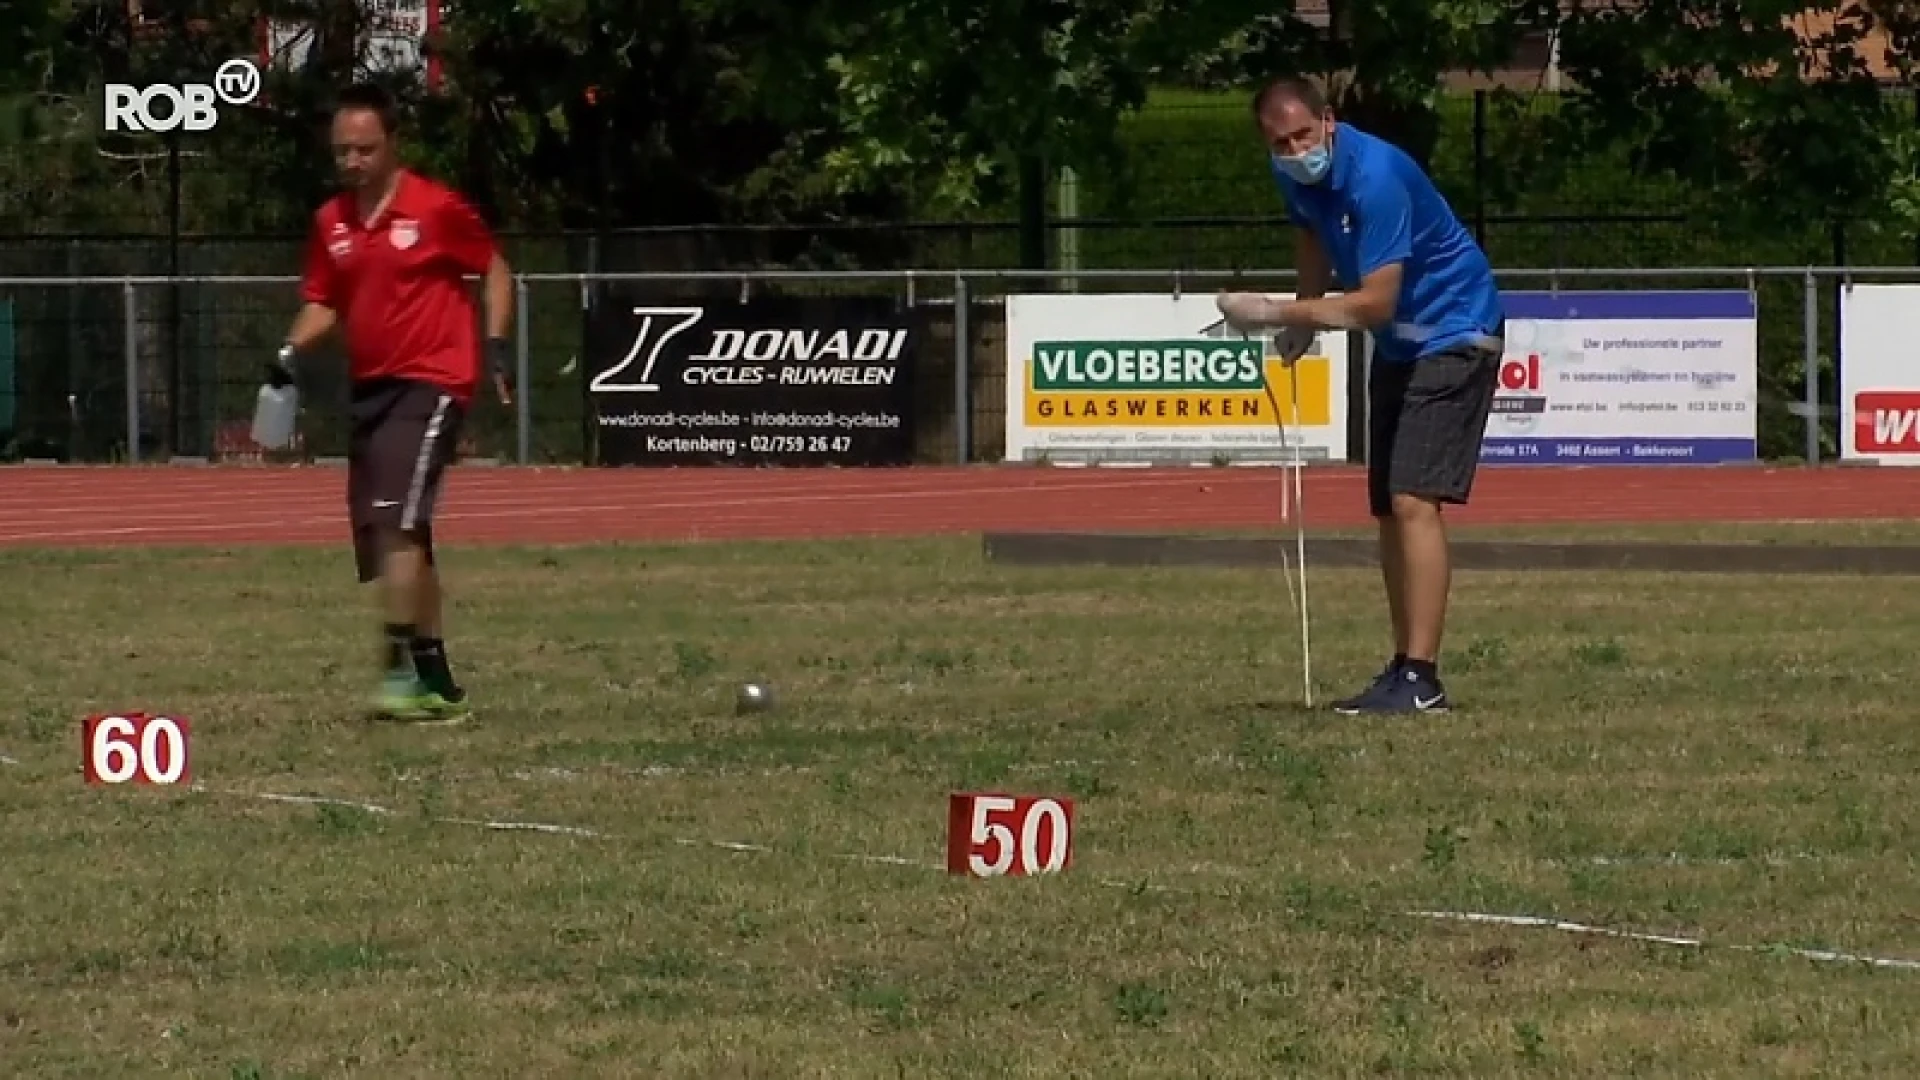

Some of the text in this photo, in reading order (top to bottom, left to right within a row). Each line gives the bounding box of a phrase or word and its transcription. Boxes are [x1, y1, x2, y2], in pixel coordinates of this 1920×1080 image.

[688, 328, 907, 360] DONADI
[1583, 337, 1723, 351] Uw professionele partner
[683, 366, 764, 385] CYCLES
[779, 366, 896, 385] RIJWIELEN
[1039, 349, 1260, 382] VLOEBERGS
[1038, 399, 1259, 416] GLASWERKEN
[599, 410, 740, 428] www.donadi-cycles.be
[751, 410, 900, 430] info@donadi-cycles.be
[647, 435, 735, 456] Kortenberg
[751, 436, 804, 452] 02/759
[808, 436, 828, 451] 26
[832, 436, 851, 451] 47
[93, 717, 185, 784] 60
[969, 797, 1068, 876] 50
